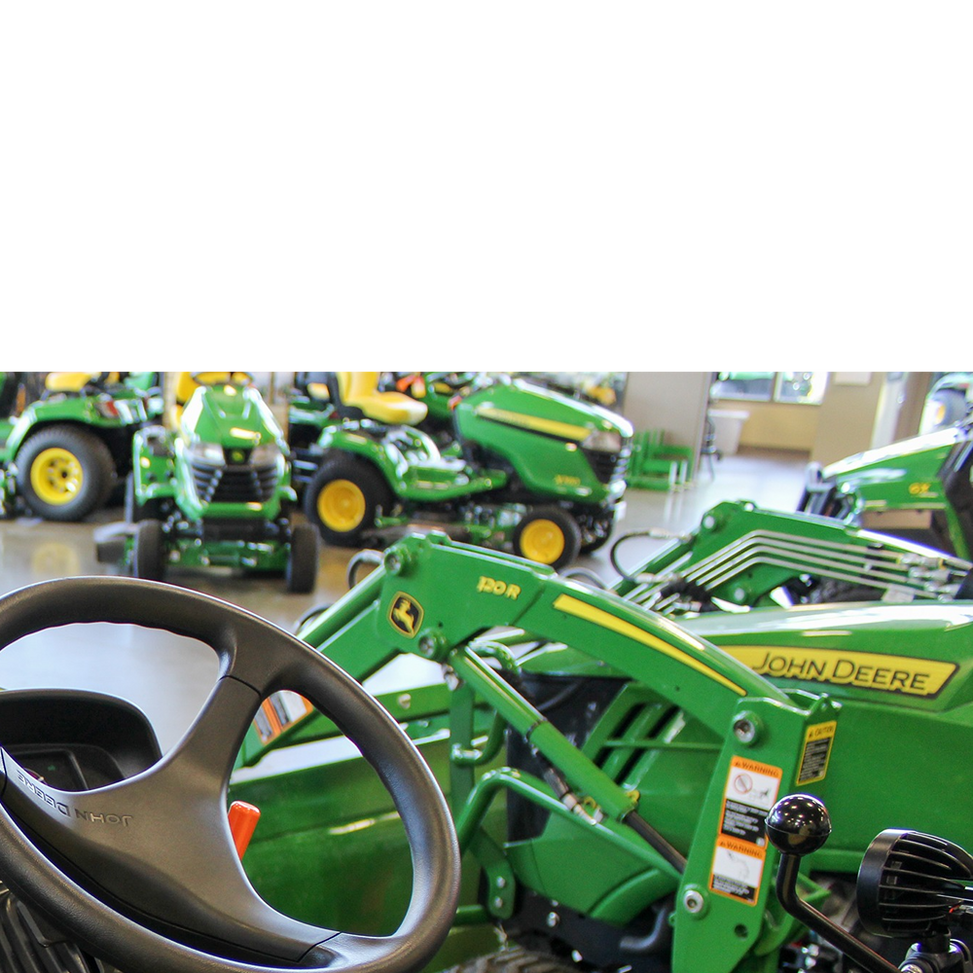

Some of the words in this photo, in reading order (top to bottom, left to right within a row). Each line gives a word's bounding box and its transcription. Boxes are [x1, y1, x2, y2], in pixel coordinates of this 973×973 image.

[752, 652, 827, 681] JOHN
[832, 659, 931, 690] DEERE
[742, 761, 779, 777] WARNING
[17, 769, 72, 818] DEERE
[75, 808, 133, 827] JOHN
[727, 842, 763, 858] WARNING
